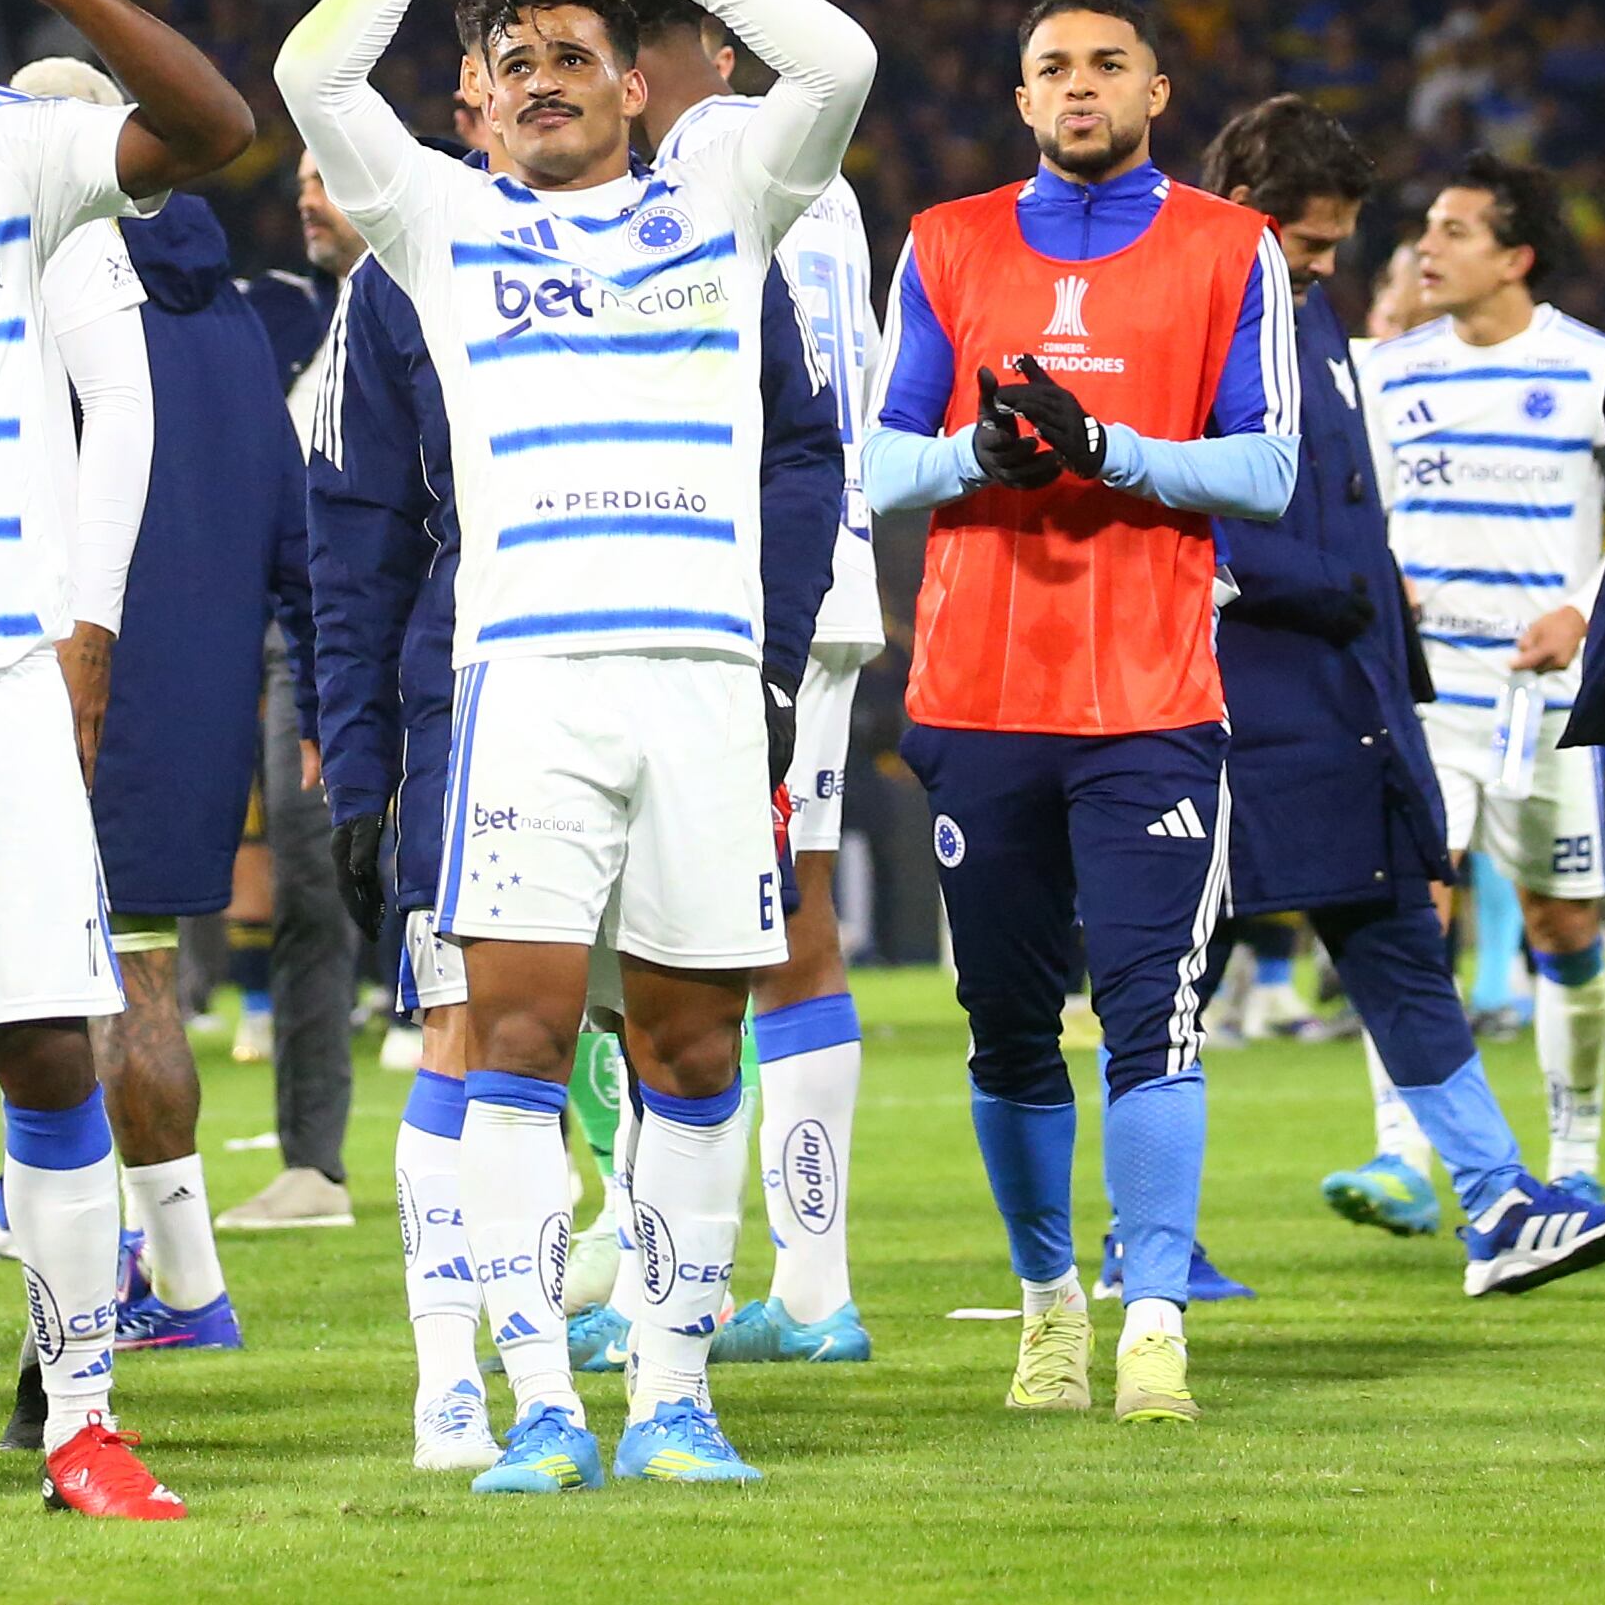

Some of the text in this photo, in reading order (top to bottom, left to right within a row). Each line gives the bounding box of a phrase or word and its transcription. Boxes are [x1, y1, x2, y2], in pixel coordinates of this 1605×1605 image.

[565, 486, 707, 514] PERDIGÃO
[1552, 834, 1593, 874] 29
[796, 1128, 826, 1220] Kodilar
[477, 1254, 533, 1285] CEC
[677, 1261, 735, 1284] CEC
